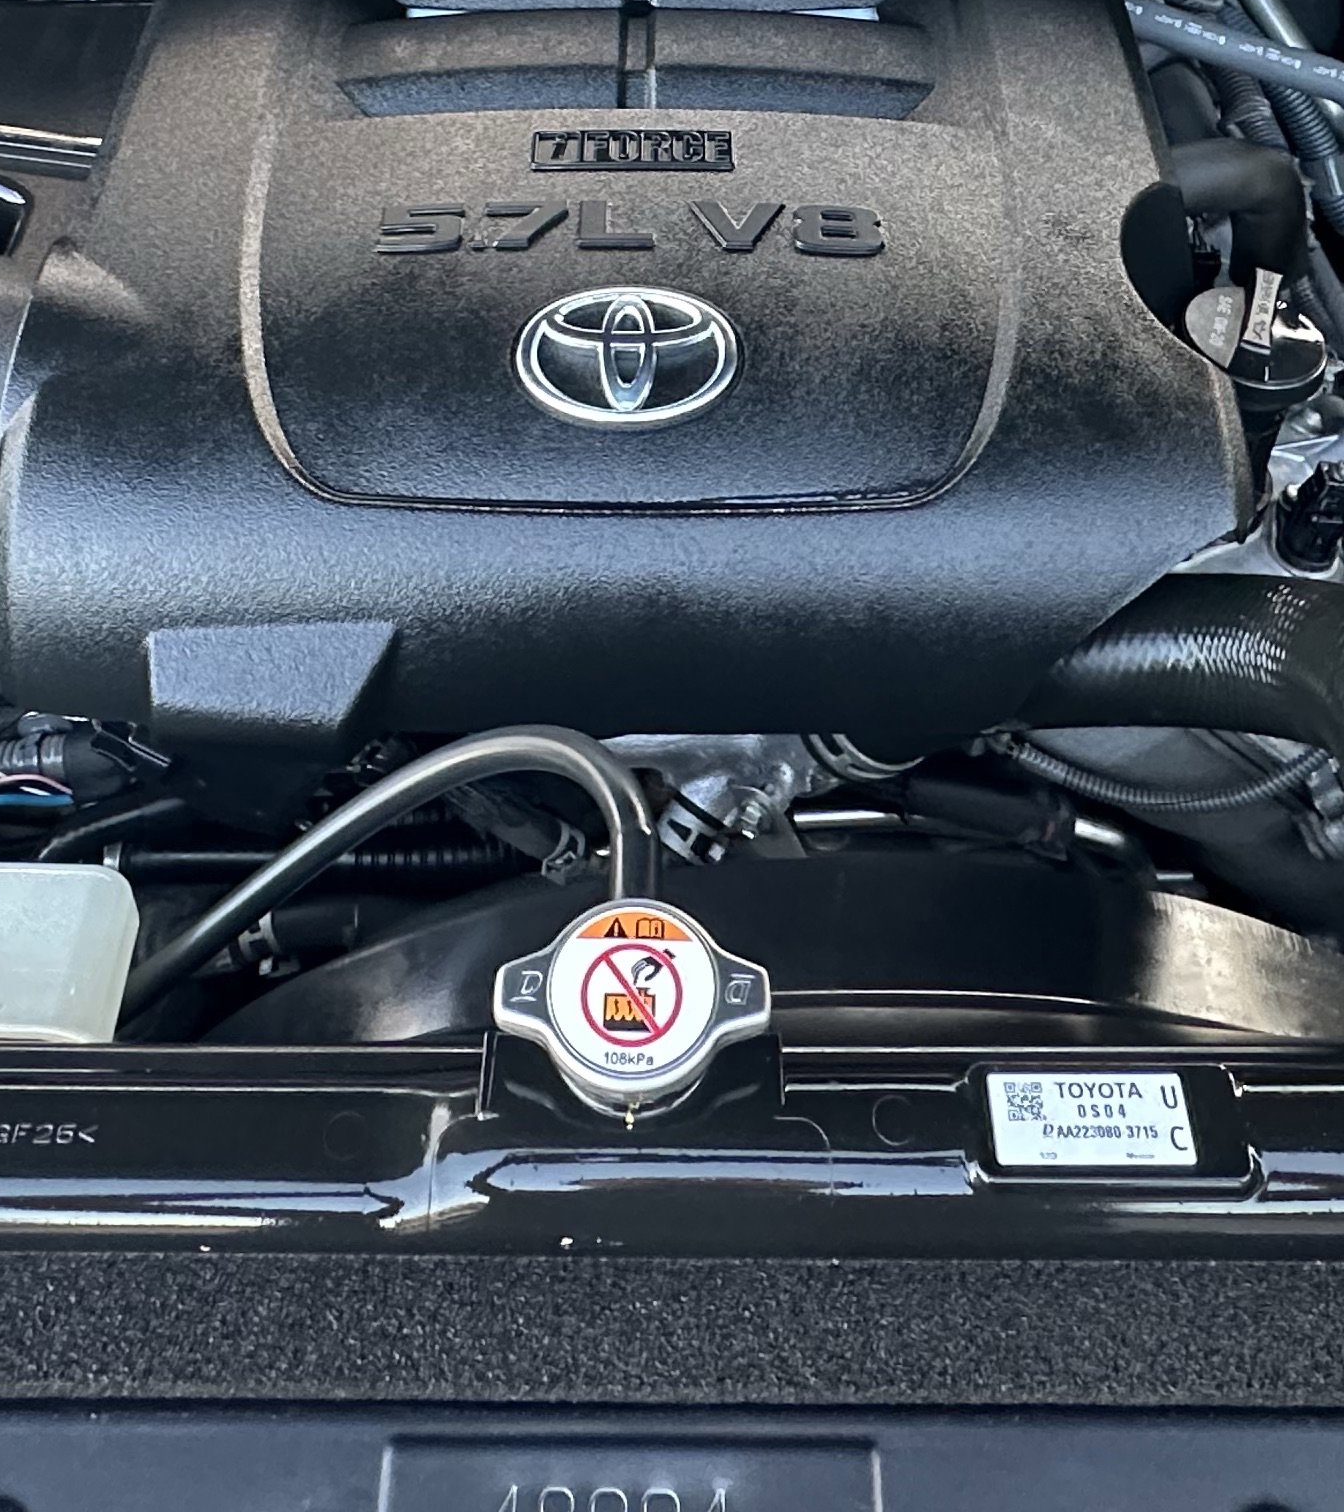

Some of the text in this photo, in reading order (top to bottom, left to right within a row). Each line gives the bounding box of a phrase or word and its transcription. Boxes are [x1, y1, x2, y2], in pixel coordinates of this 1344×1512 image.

[689, 200, 887, 257] V8
[603, 1051, 654, 1066] 108kPa
[1054, 1082, 1179, 1109] TOYOTA U
[1126, 1125, 1159, 1139] 3715
[1170, 1126, 1189, 1151] C
